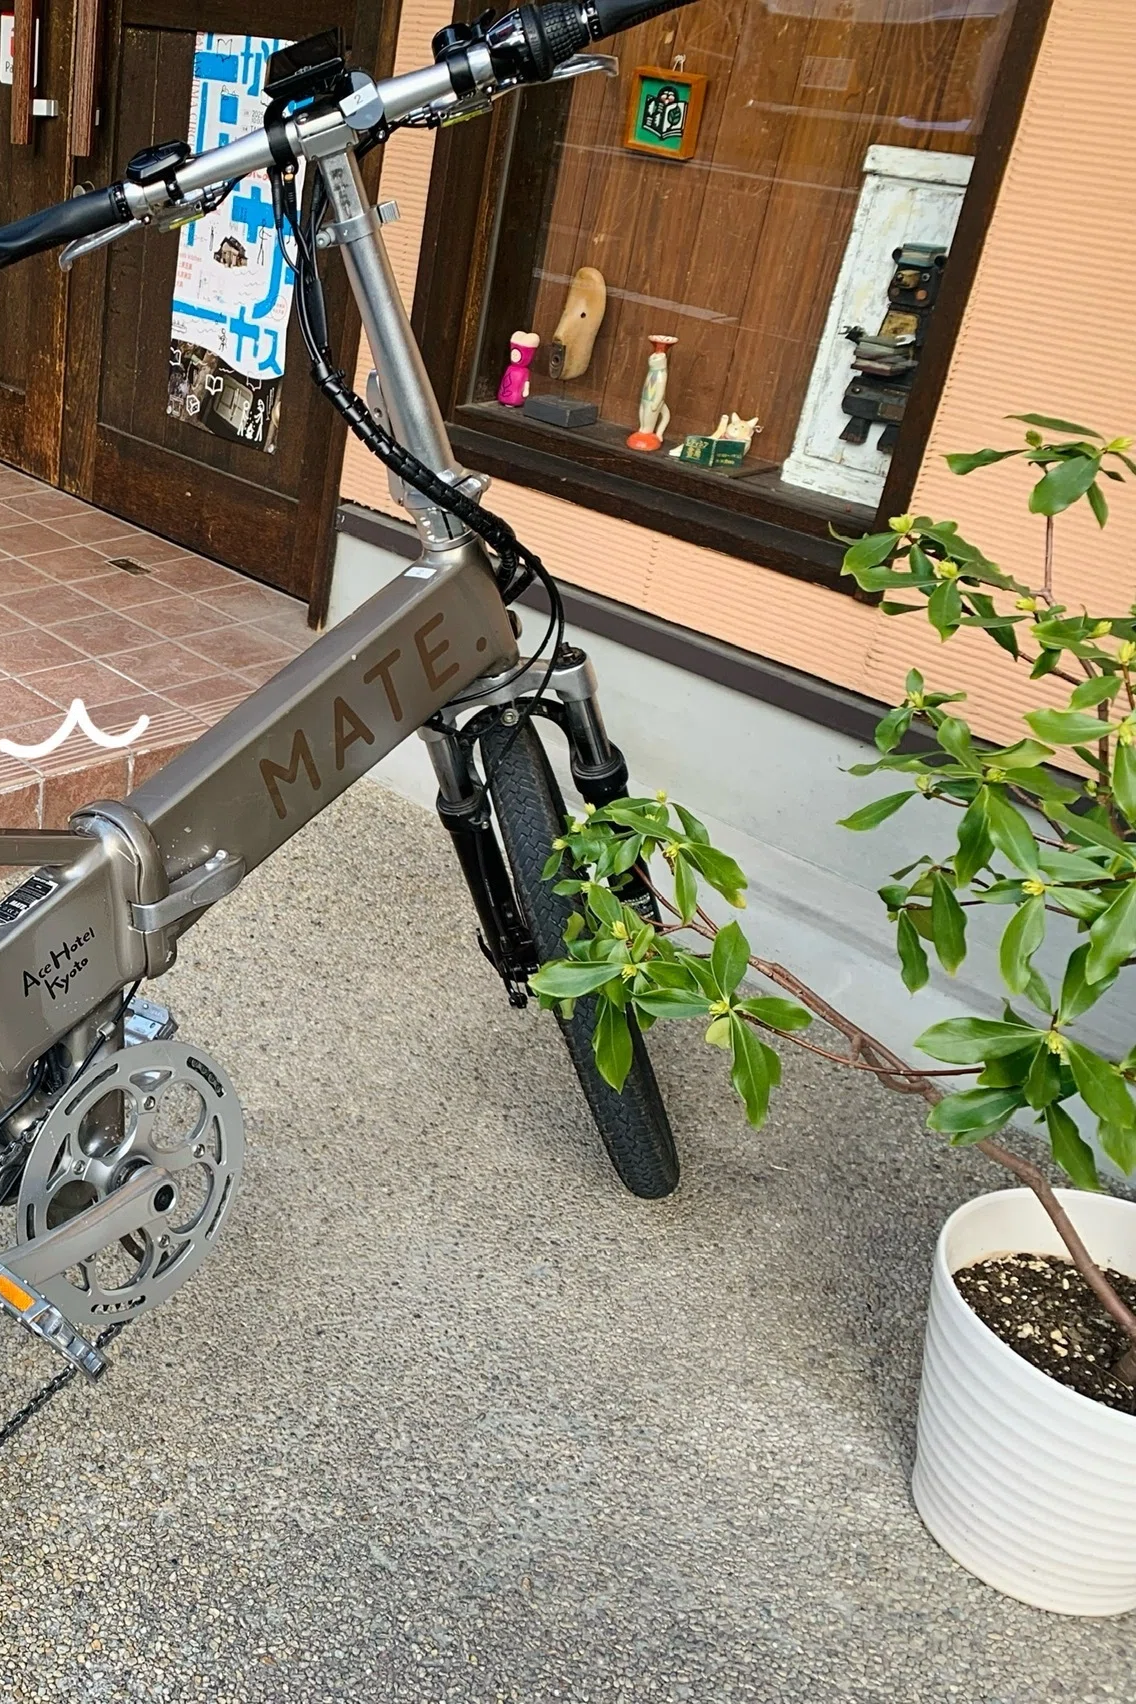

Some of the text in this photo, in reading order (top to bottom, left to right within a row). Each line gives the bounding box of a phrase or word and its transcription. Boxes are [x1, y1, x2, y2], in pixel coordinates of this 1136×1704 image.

[354, 95, 363, 104] 2
[259, 612, 487, 820] MATE.
[23, 927, 95, 997] Ace Hotel
[44, 958, 88, 999] Kyoto
